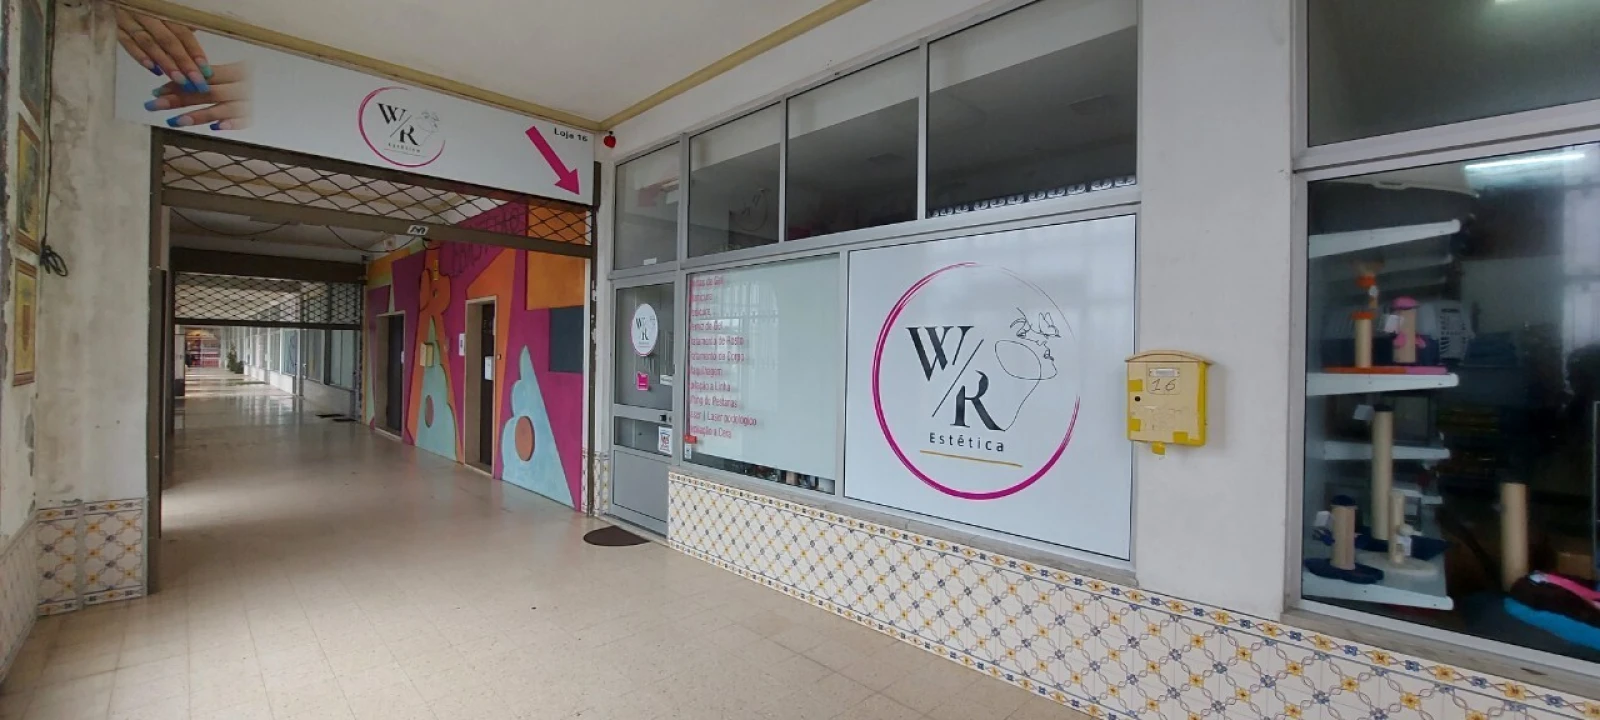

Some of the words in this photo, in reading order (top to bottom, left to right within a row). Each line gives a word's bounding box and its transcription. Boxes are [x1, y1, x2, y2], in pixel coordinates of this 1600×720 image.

[554, 127, 574, 140] Loja
[577, 134, 588, 142] 16
[929, 432, 1005, 452] Estética
